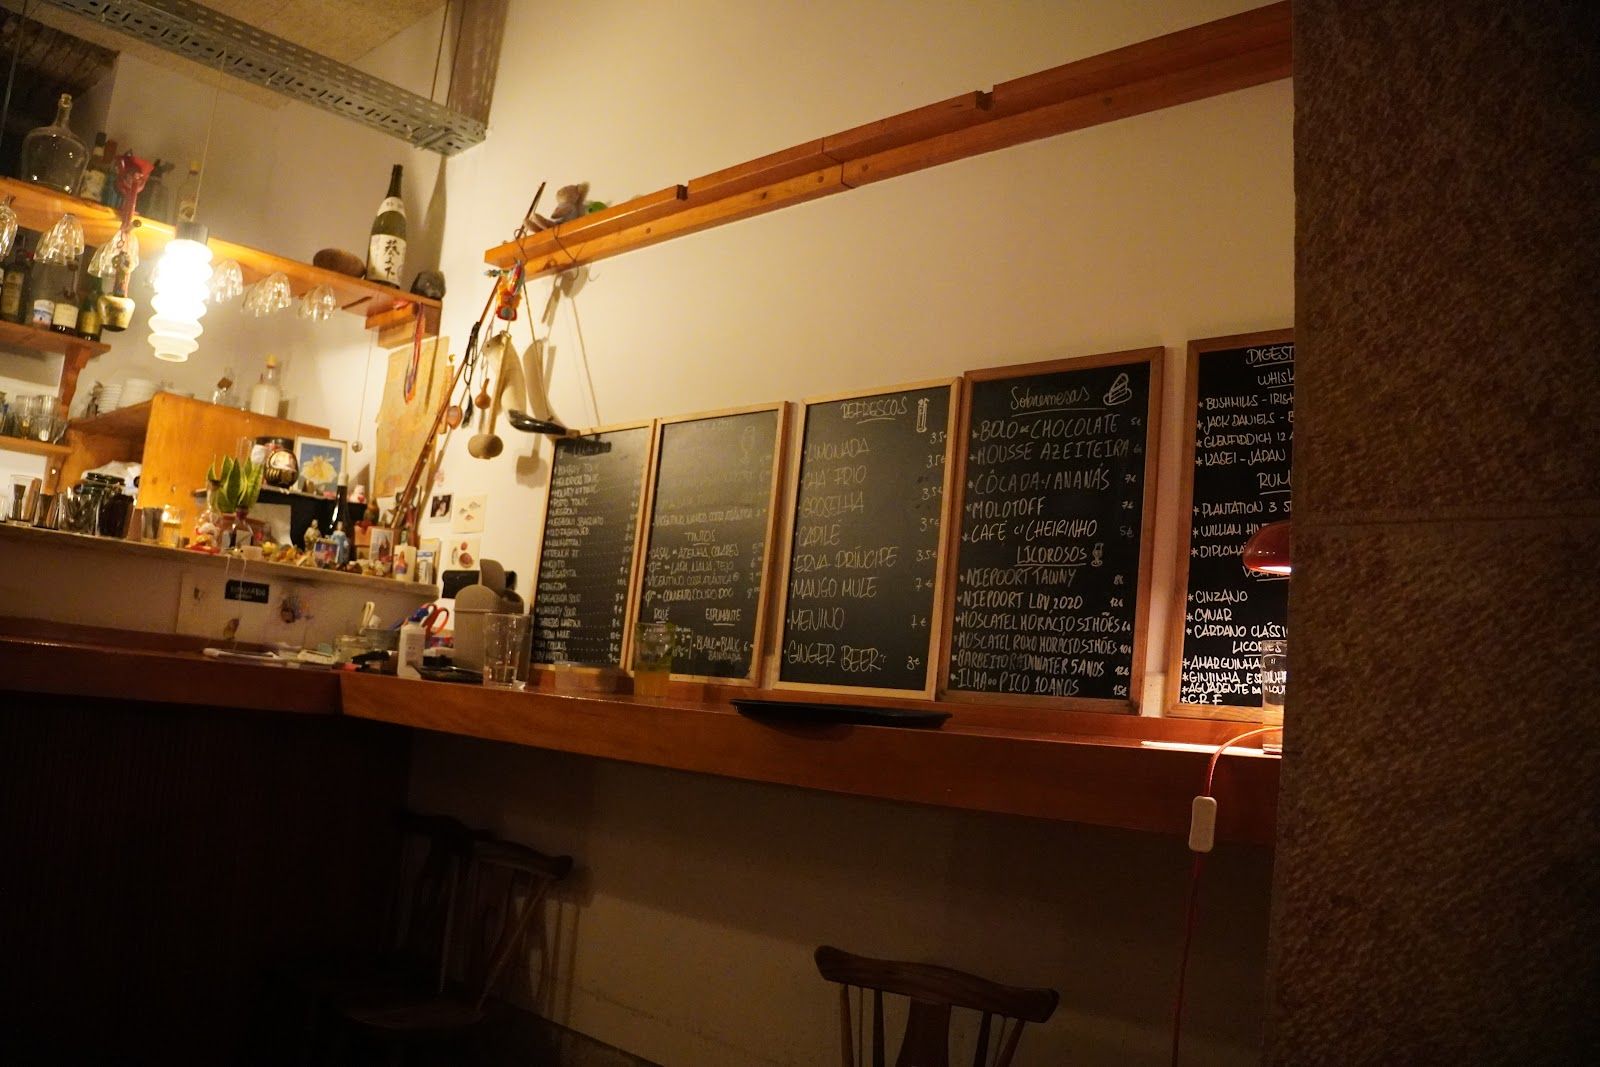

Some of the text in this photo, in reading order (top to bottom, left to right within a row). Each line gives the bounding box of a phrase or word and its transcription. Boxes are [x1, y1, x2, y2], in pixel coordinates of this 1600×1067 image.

[980, 420, 1018, 441] BOLO
[1030, 414, 1120, 439] CHOCOLATE
[1269, 501, 1278, 513] 3
[1025, 519, 1098, 542] CHEIRINHO
[1195, 589, 1248, 605] CINZANO
[1194, 608, 1232, 623] CYNAR
[1250, 621, 1288, 638] CLÁSSI
[999, 671, 1030, 692] PICO
